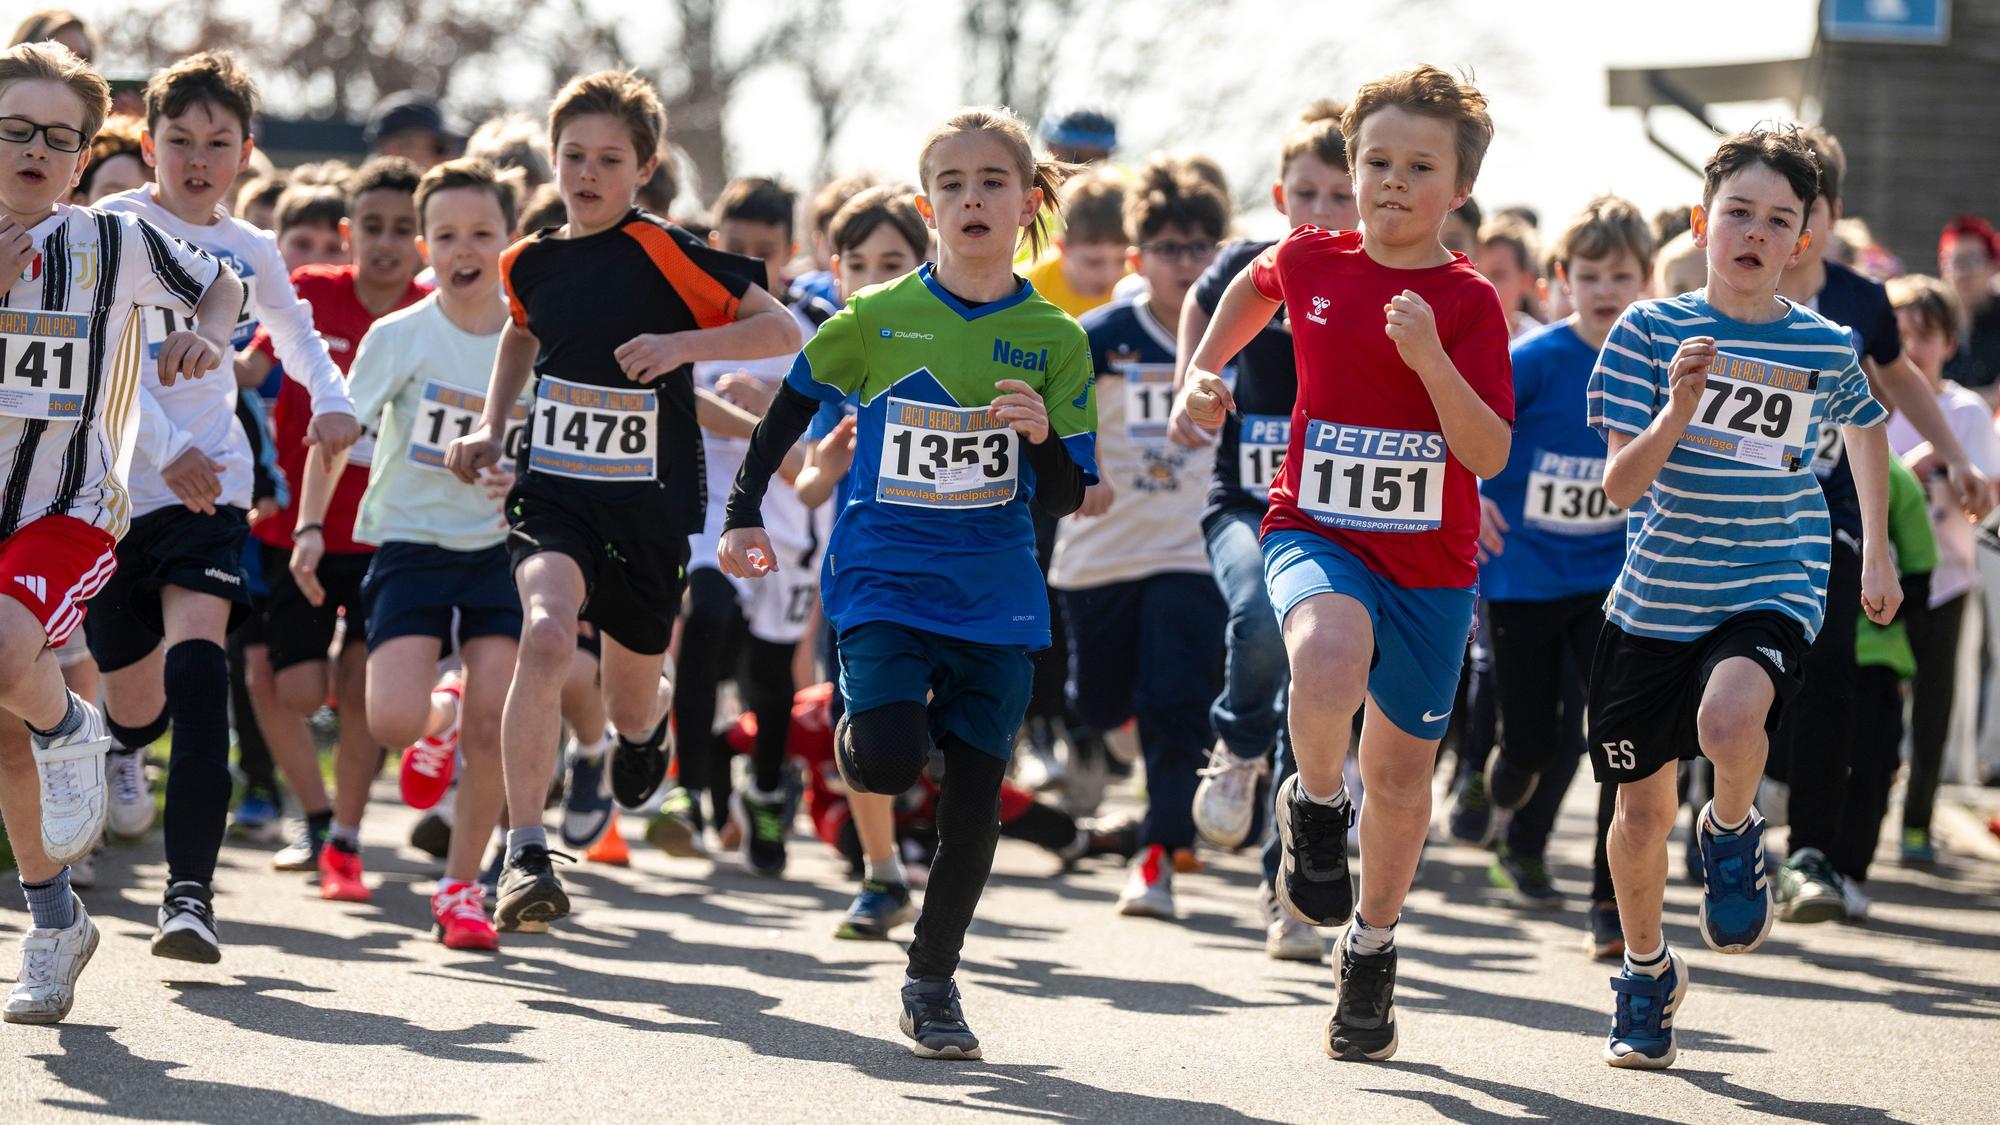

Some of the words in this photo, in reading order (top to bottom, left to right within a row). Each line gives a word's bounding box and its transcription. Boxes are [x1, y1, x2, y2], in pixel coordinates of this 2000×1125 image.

[993, 339, 1048, 372] Neal
[1730, 360, 1765, 383] BEACH
[900, 406, 925, 427] LAGO
[929, 411, 961, 431] BEACH
[1702, 379, 1793, 438] 729
[542, 405, 647, 454] 1478
[1315, 424, 1444, 459] PETERS
[893, 430, 1009, 480] 1353
[885, 486, 1010, 502] www.lago-zuelpich.de
[1313, 459, 1428, 513] 1151
[1313, 514, 1429, 531] WWW.PETERSSPORTTEAM.DE
[1602, 739, 1636, 770] ES
